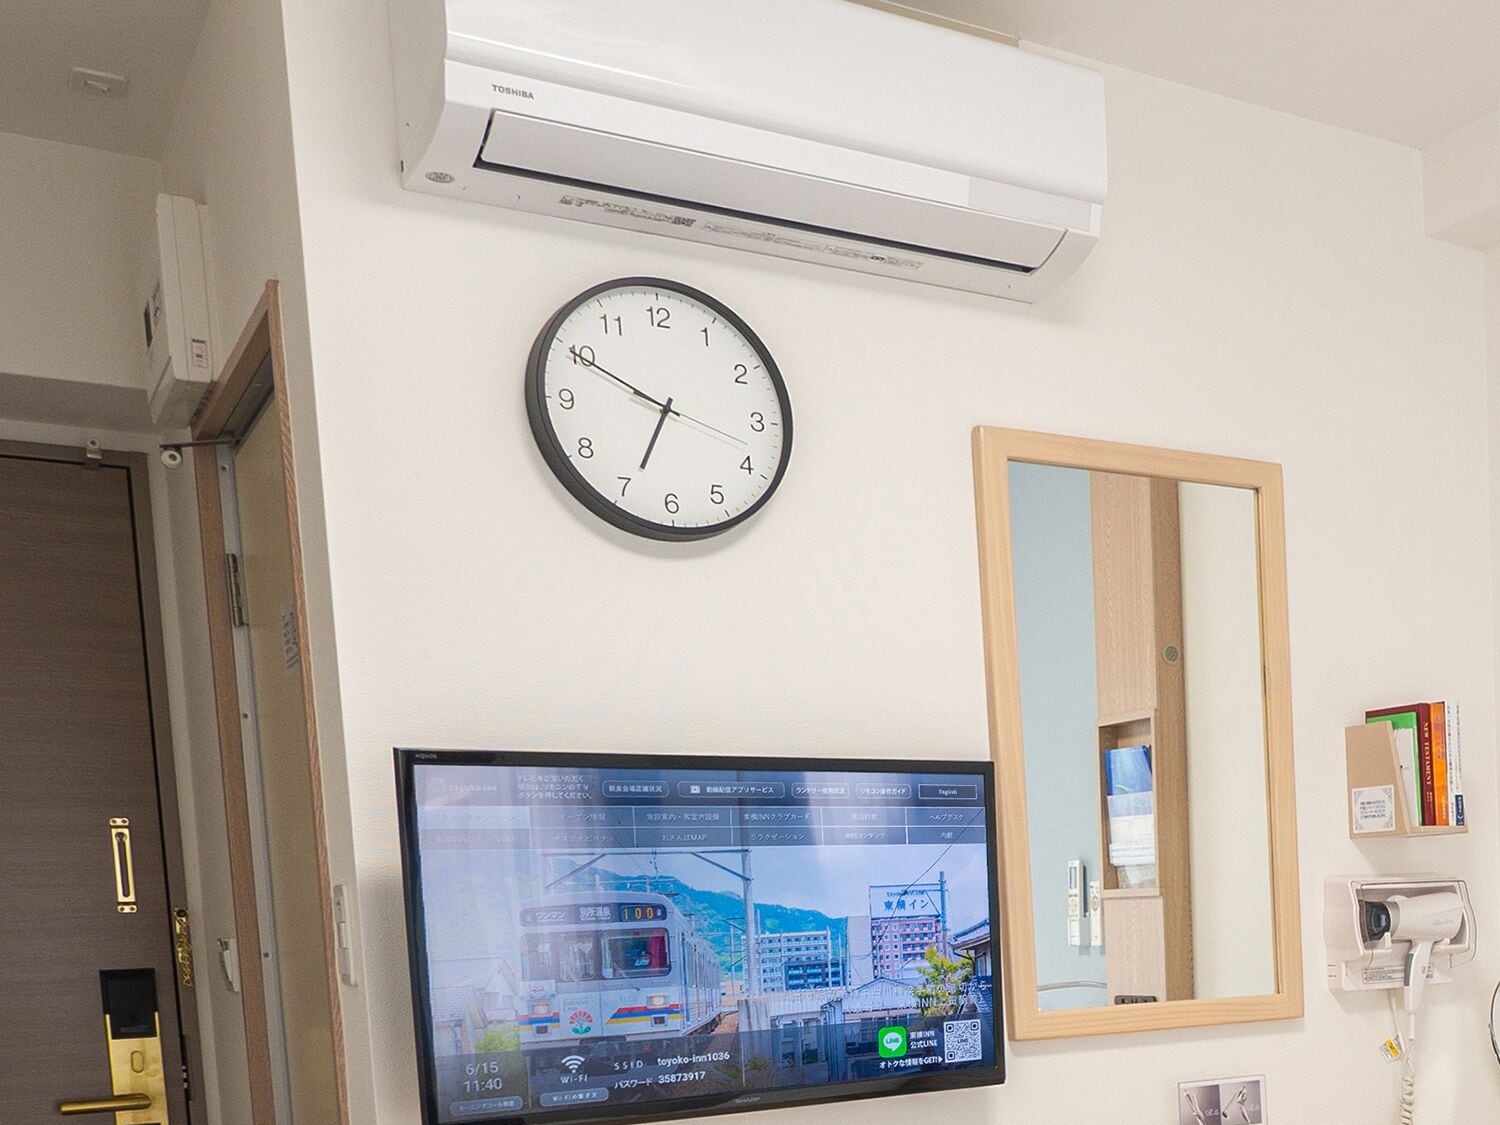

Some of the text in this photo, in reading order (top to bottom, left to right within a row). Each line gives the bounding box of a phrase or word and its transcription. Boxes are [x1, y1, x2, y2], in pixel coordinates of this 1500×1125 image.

[491, 84, 535, 100] TOSHIBA
[600, 314, 624, 336] 11
[646, 306, 671, 329] 12
[700, 327, 710, 347] 1
[569, 345, 596, 367] 10
[733, 363, 748, 385] 2
[558, 388, 575, 410] 9
[750, 411, 765, 432] 3
[577, 437, 594, 458] 8
[739, 455, 754, 475] 4
[616, 476, 632, 497] 7
[710, 484, 725, 505] 5
[664, 493, 680, 514] 6
[1424, 741, 1432, 785] TESTAMENT
[885, 1037, 900, 1045] LINE
[465, 1060, 499, 1076] 6/15
[657, 1051, 730, 1068] toyoko-inn1036
[464, 1077, 502, 1093] 11:40
[614, 1071, 706, 1090] パスワード 35873917
